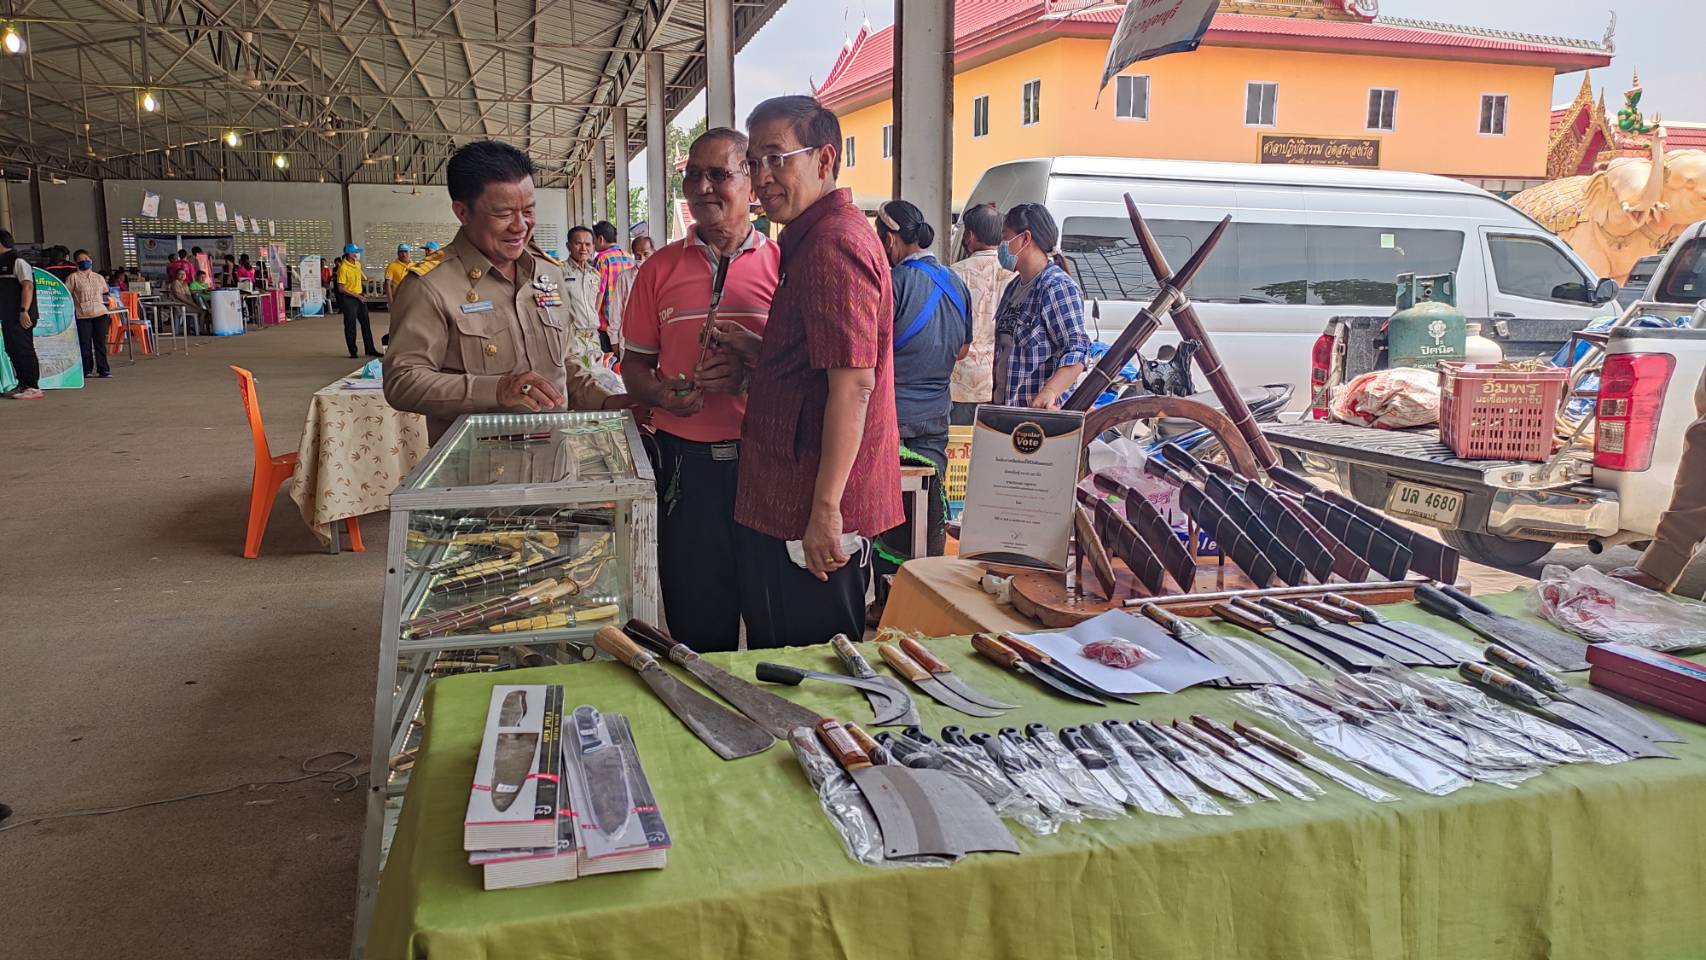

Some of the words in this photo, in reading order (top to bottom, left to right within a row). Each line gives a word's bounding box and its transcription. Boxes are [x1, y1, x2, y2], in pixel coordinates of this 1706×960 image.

[1481, 378, 1540, 394] อัมพร
[1016, 437, 1039, 447] Vote
[1401, 487, 1420, 504] บล
[1425, 492, 1457, 512] 4680
